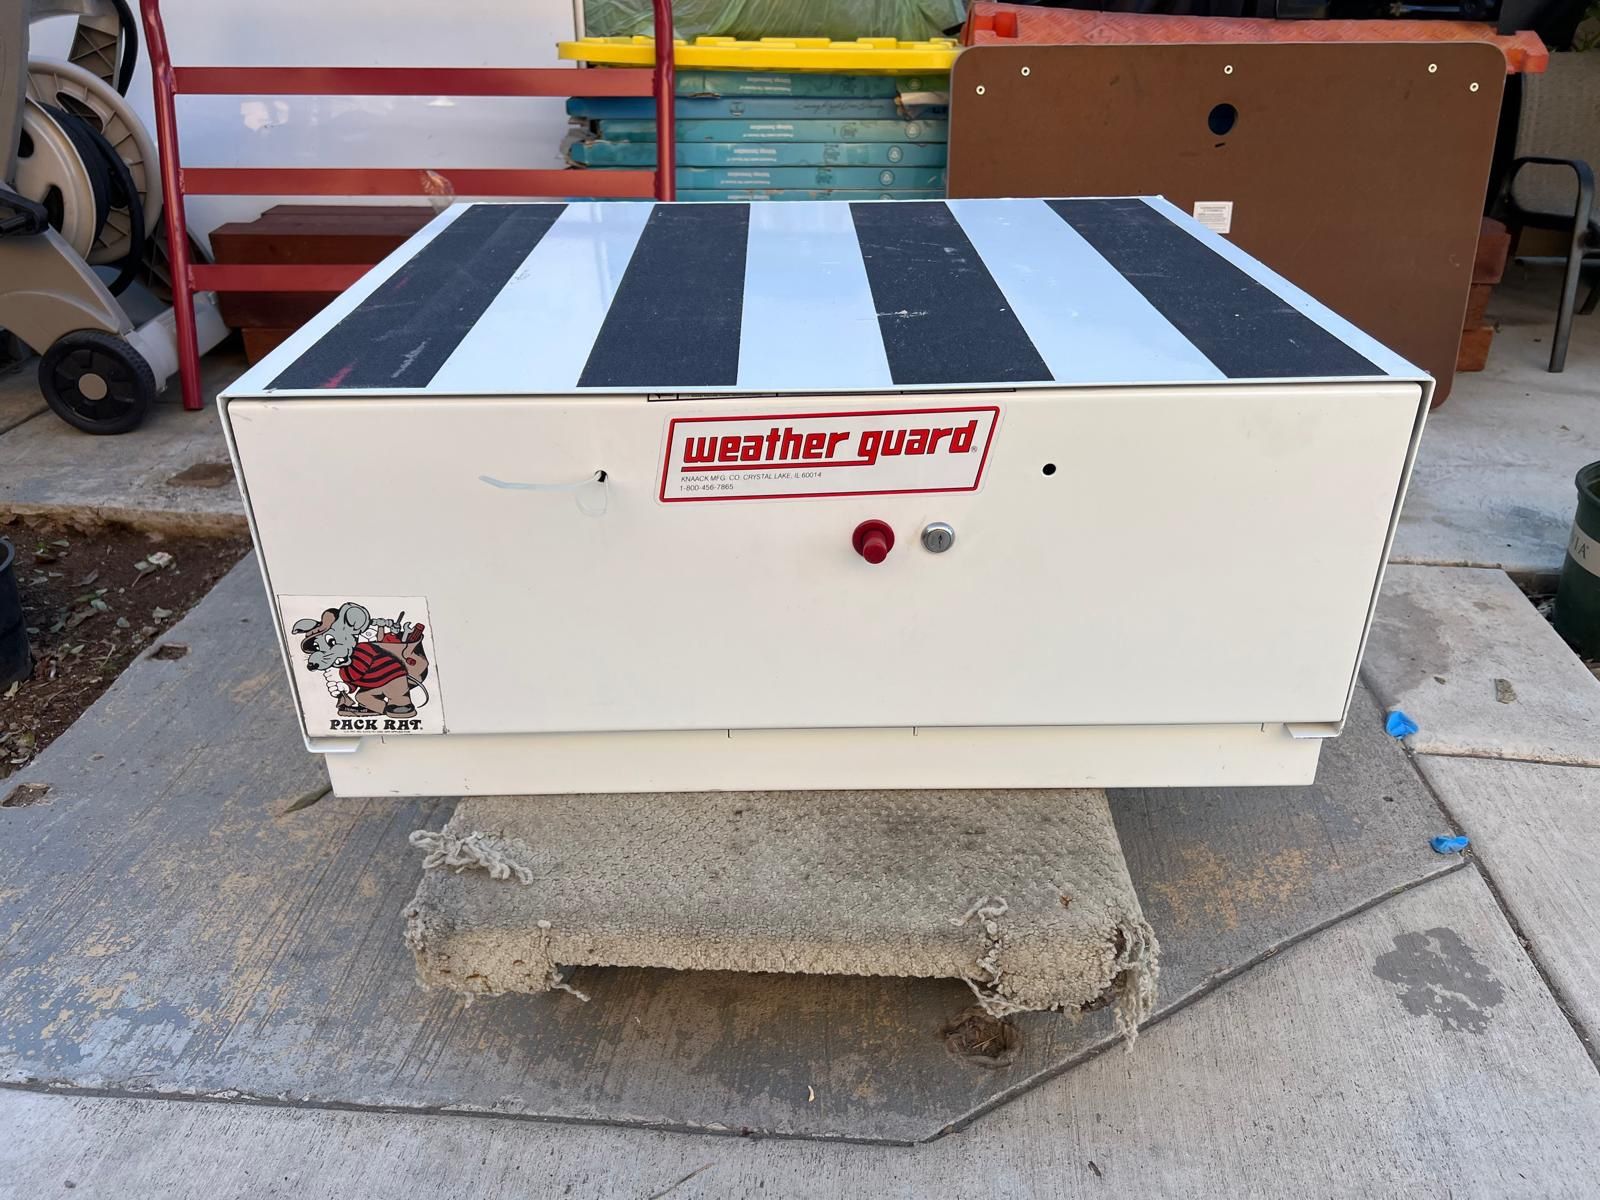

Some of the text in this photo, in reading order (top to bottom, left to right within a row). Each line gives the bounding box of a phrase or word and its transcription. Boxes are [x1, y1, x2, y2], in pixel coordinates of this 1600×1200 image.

[683, 426, 850, 464] weather
[743, 473, 774, 481] CRYSTAL
[801, 471, 822, 479] 60014
[680, 483, 734, 491] 1-800-456-7865
[330, 719, 378, 730] PACK
